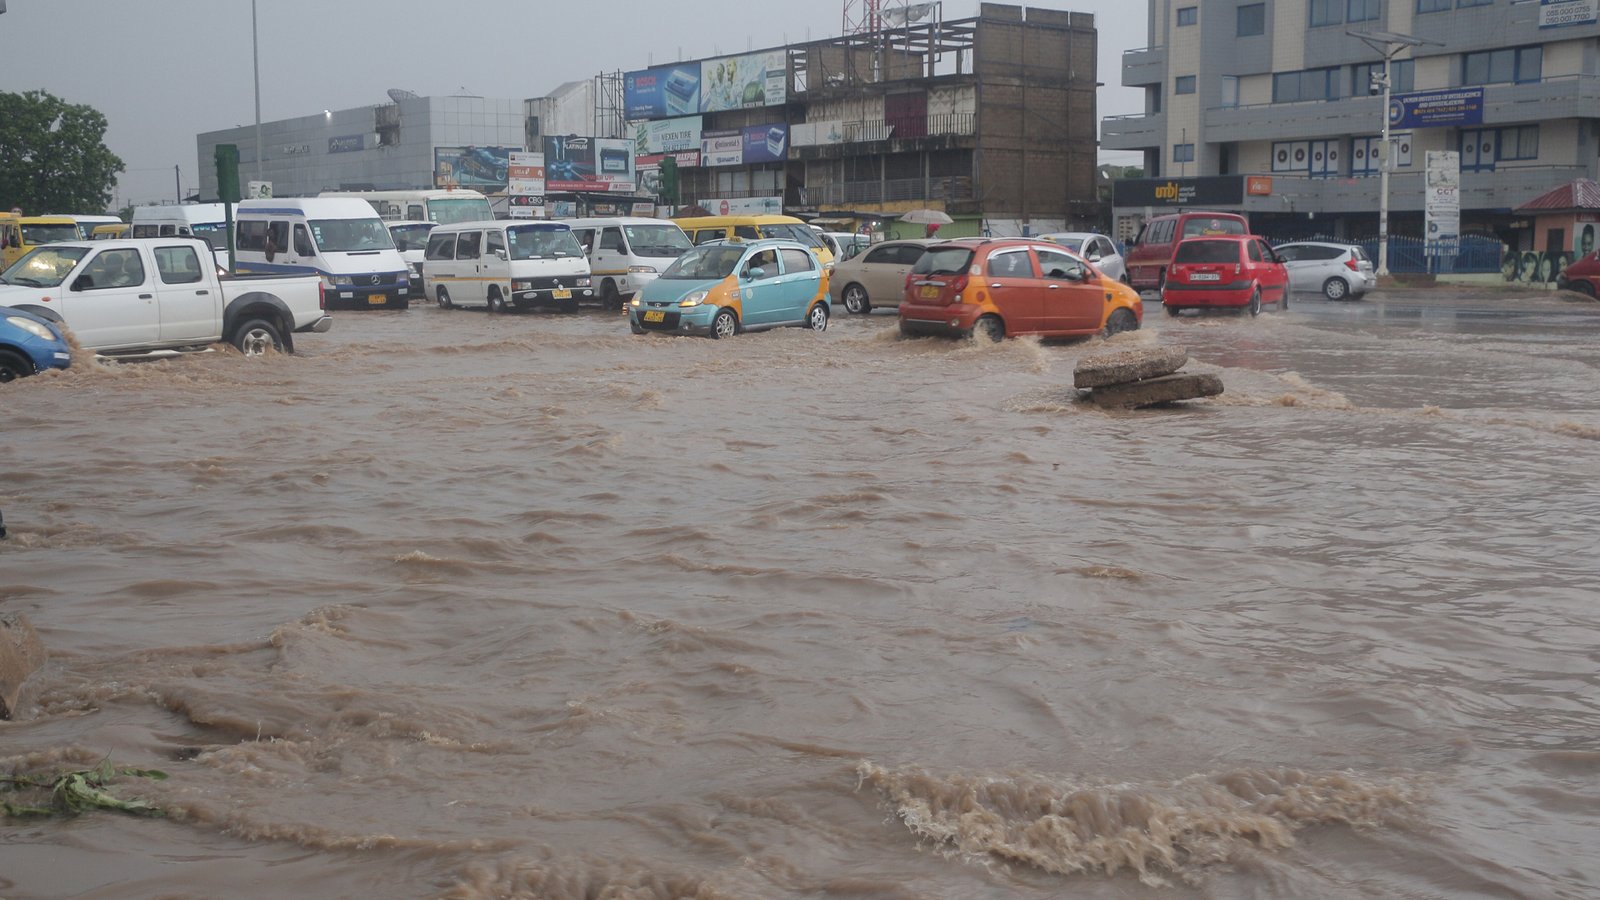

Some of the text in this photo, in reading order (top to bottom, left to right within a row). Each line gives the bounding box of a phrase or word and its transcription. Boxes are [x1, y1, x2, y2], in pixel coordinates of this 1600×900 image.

[636, 76, 656, 88] BOSCH
[661, 130, 691, 141] NEXEN TIRE
[528, 196, 543, 204] CBG
